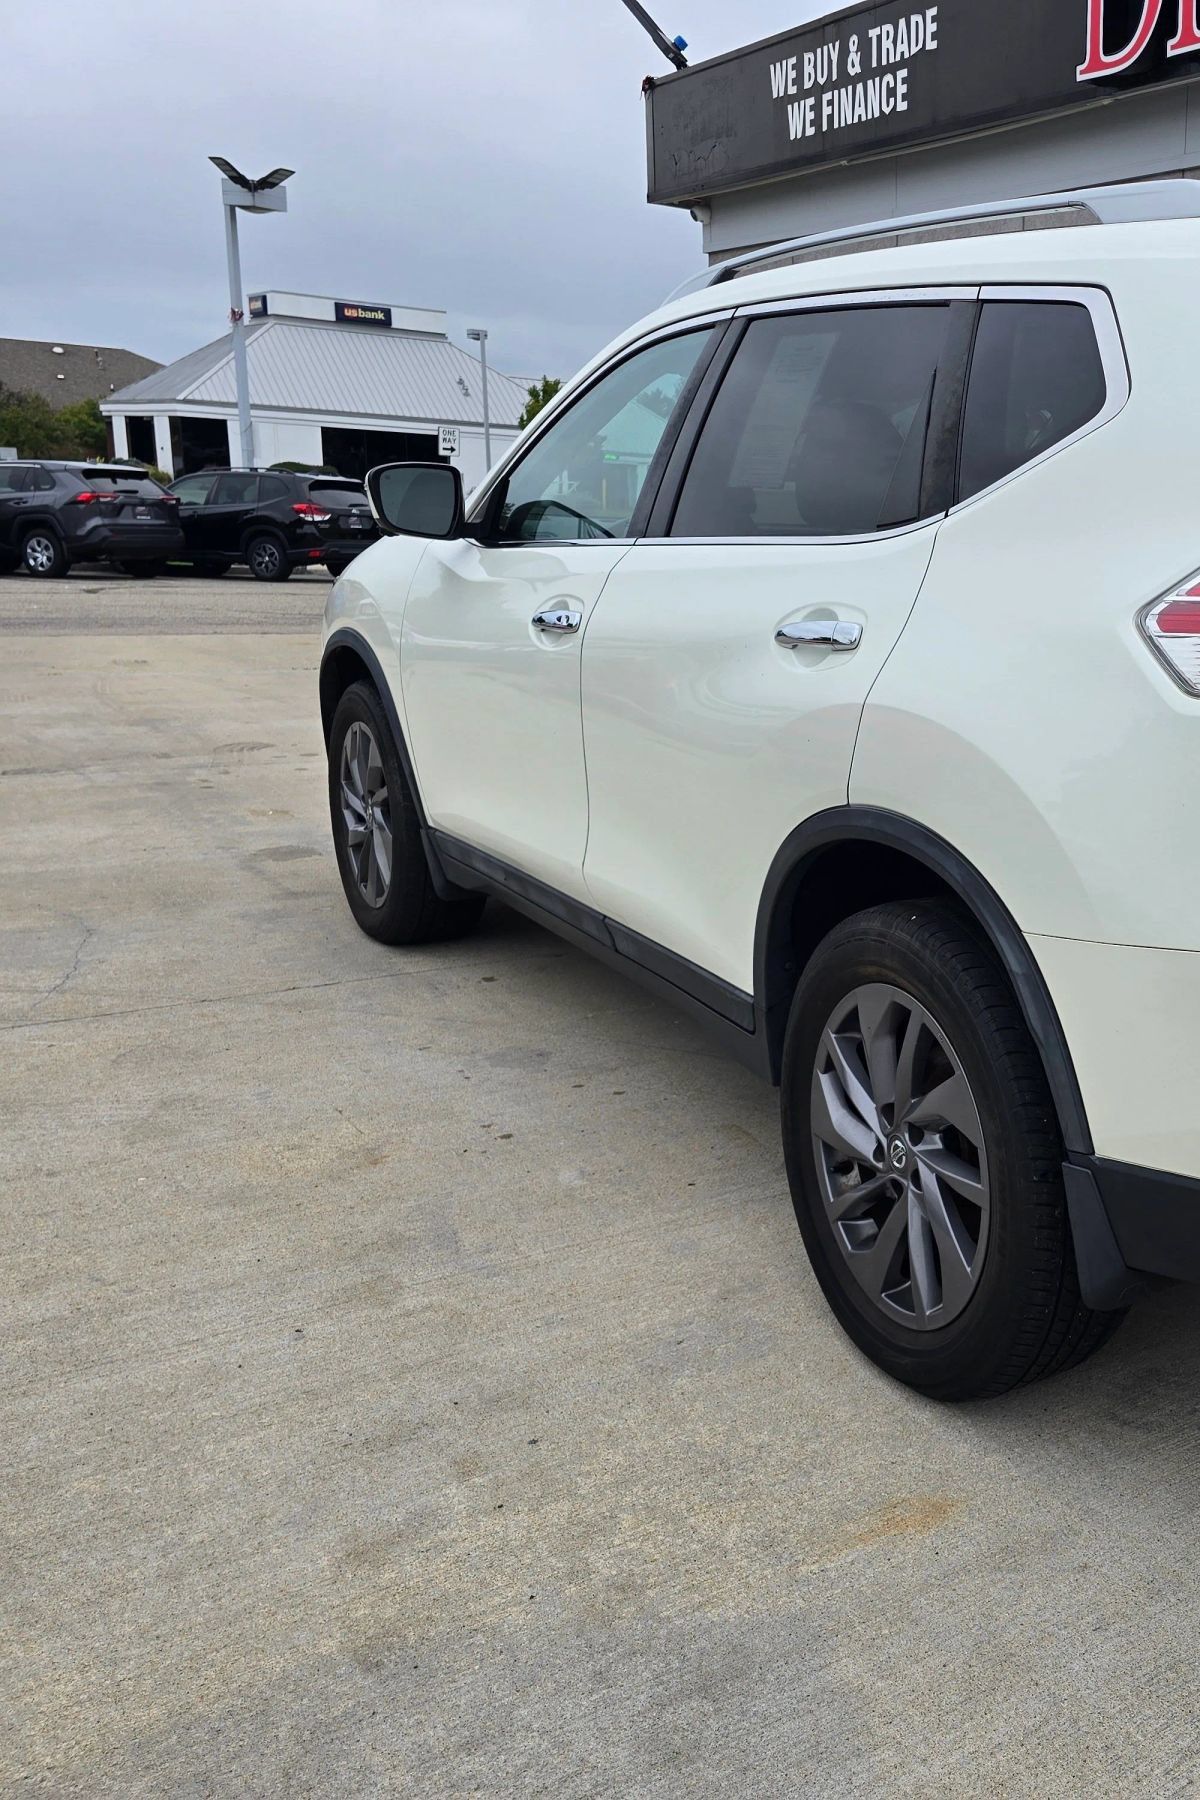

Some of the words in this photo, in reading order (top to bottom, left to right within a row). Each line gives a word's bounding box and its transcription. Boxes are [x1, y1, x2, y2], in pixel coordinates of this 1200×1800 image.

[769, 55, 798, 99] WE
[803, 39, 840, 90] BUY
[846, 34, 862, 76] &
[868, 5, 938, 68] TRADE
[787, 96, 816, 141] WE
[822, 68, 908, 132] FINANCE
[442, 429, 457, 437] ONE
